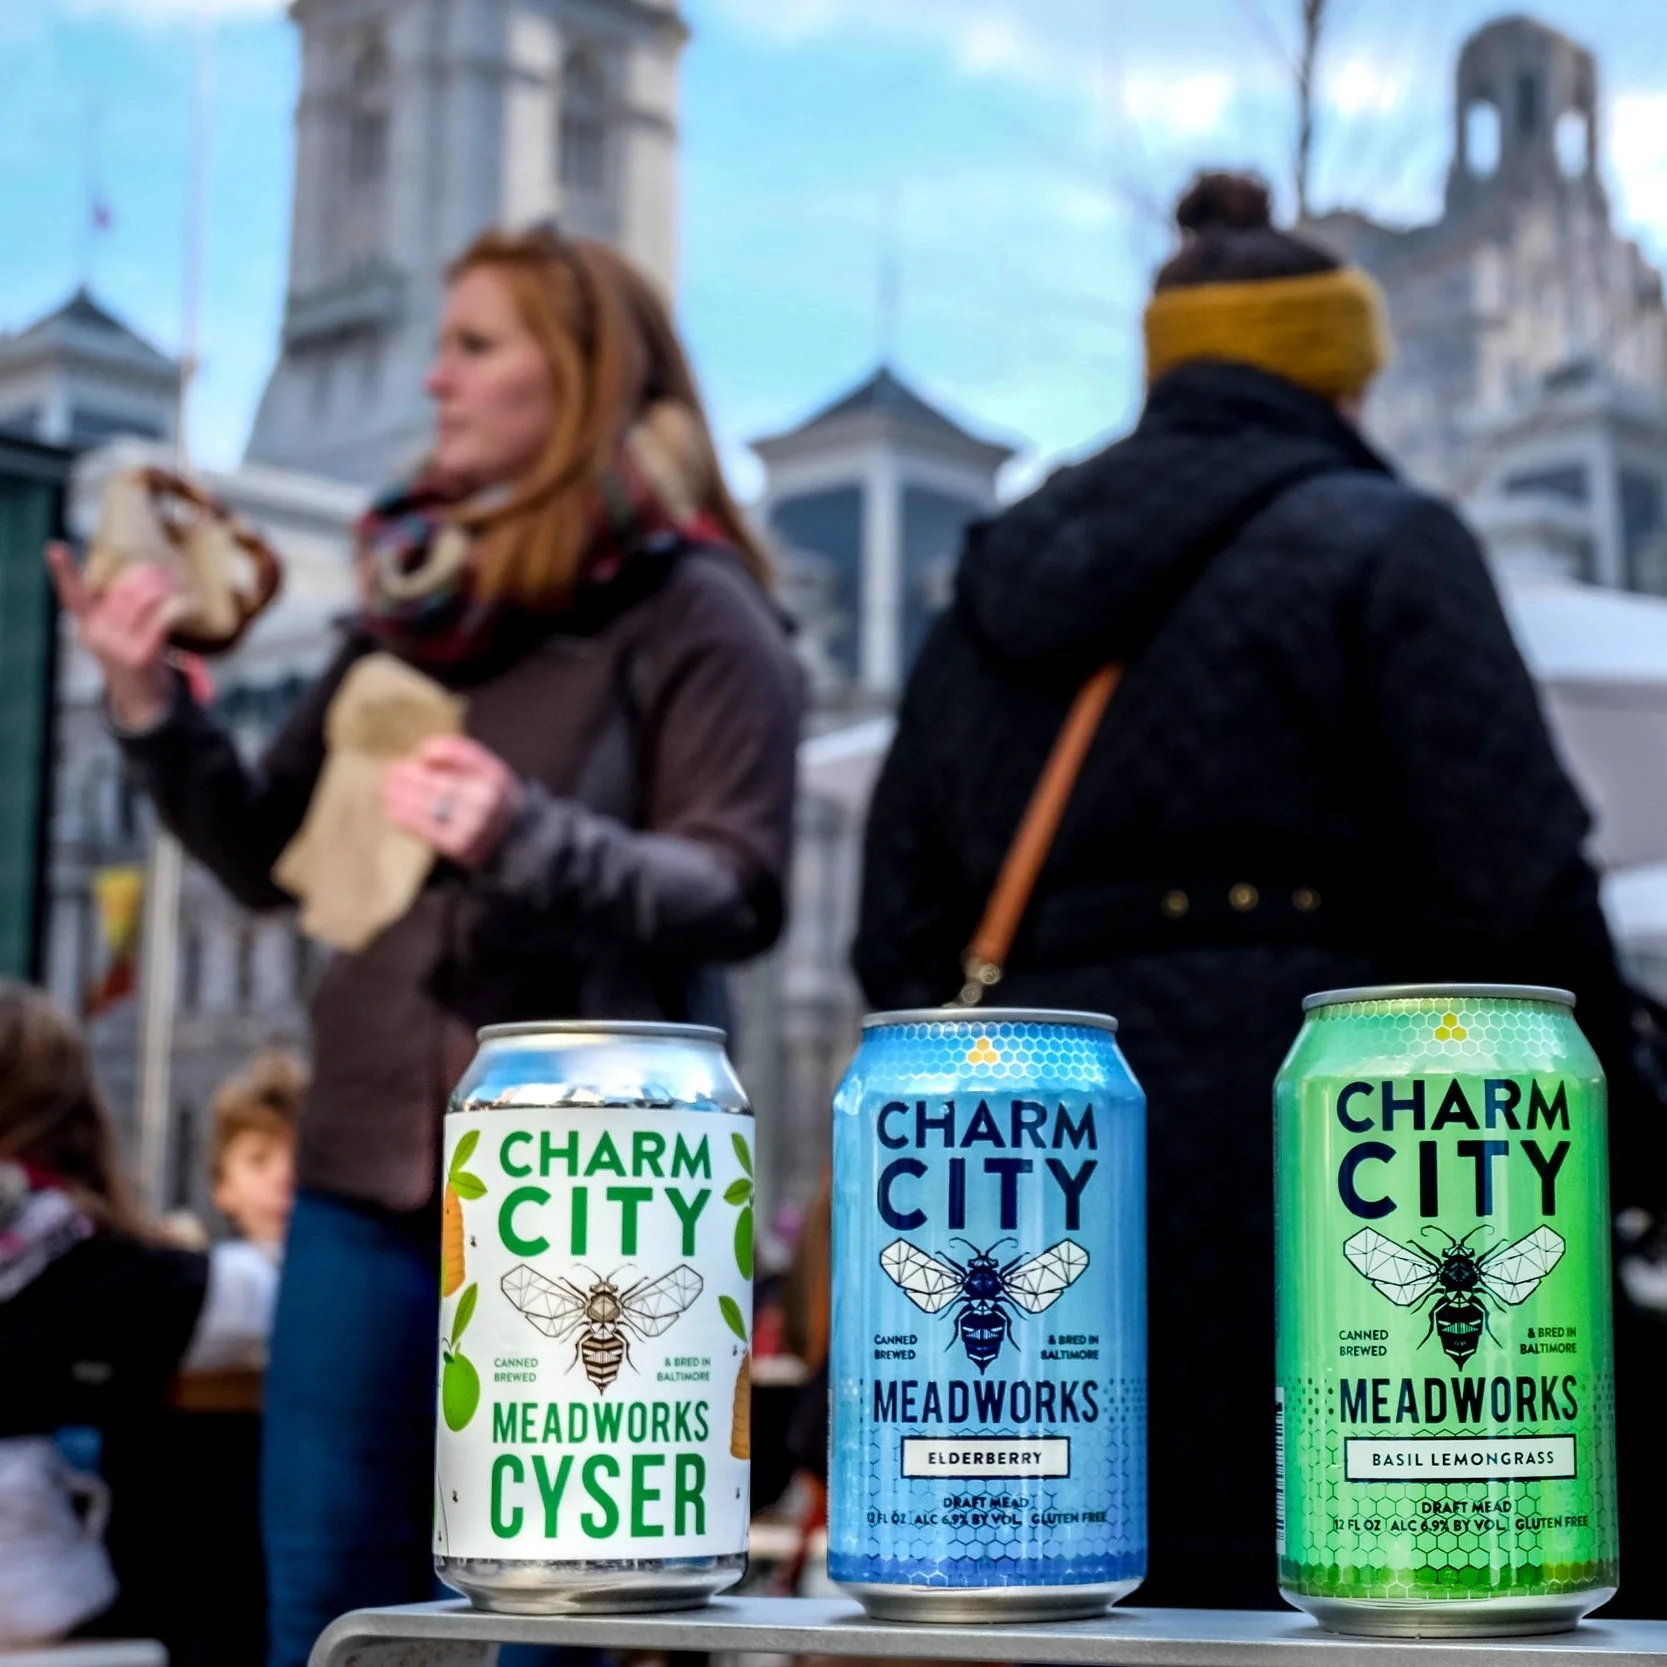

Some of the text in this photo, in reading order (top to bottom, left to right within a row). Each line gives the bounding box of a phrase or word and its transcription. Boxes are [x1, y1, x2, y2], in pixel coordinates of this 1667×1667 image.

[1337, 1079, 1570, 1133] CHARM
[877, 1099, 1098, 1150] CHARM
[500, 1130, 712, 1179] CHARM
[1338, 1140, 1570, 1219] CITY
[877, 1157, 1098, 1231] CITY
[498, 1186, 712, 1257] CITY
[1339, 1330, 1388, 1340] CANNED
[1528, 1327, 1576, 1338] & BRED IN
[874, 1334, 918, 1345] CANNED
[1047, 1335, 1099, 1345] & BRED IN
[874, 1349, 916, 1360] BREWED
[1041, 1349, 1099, 1360] BALTIMORE
[1340, 1346, 1387, 1356] BREWED
[1520, 1343, 1576, 1354] BALTIMORE
[494, 1358, 538, 1368] CANNED
[664, 1357, 711, 1367] & BRED IN
[494, 1372, 537, 1382] BREWED
[657, 1372, 711, 1382] BALTIMORE
[874, 1380, 1098, 1423] MEADWORKS
[1340, 1376, 1578, 1423] MEADWORKS
[493, 1401, 709, 1443] MEADWORKS
[928, 1452, 1042, 1464] ELDERBERRY
[1373, 1451, 1554, 1466] BASIL LEMONGRASS
[491, 1453, 706, 1539] CYSER
[944, 1496, 1029, 1508] DRAFT MEAD
[1422, 1501, 1512, 1513] DRAFT MEAD
[878, 1513, 888, 1524] FL
[891, 1513, 906, 1524] OZ
[914, 1514, 938, 1525] ALC
[972, 1513, 988, 1525] BY
[1031, 1512, 1079, 1525] GLUTEN
[1082, 1511, 1107, 1523] FREE
[1334, 1519, 1344, 1530] 12
[1348, 1519, 1360, 1531] FL
[1364, 1520, 1381, 1531] OZ
[1390, 1520, 1417, 1531] ALC
[1421, 1519, 1449, 1531] 6.9%
[1453, 1519, 1470, 1531] BY
[1515, 1516, 1561, 1530] GLUTEN
[1565, 1515, 1588, 1527] FREE
